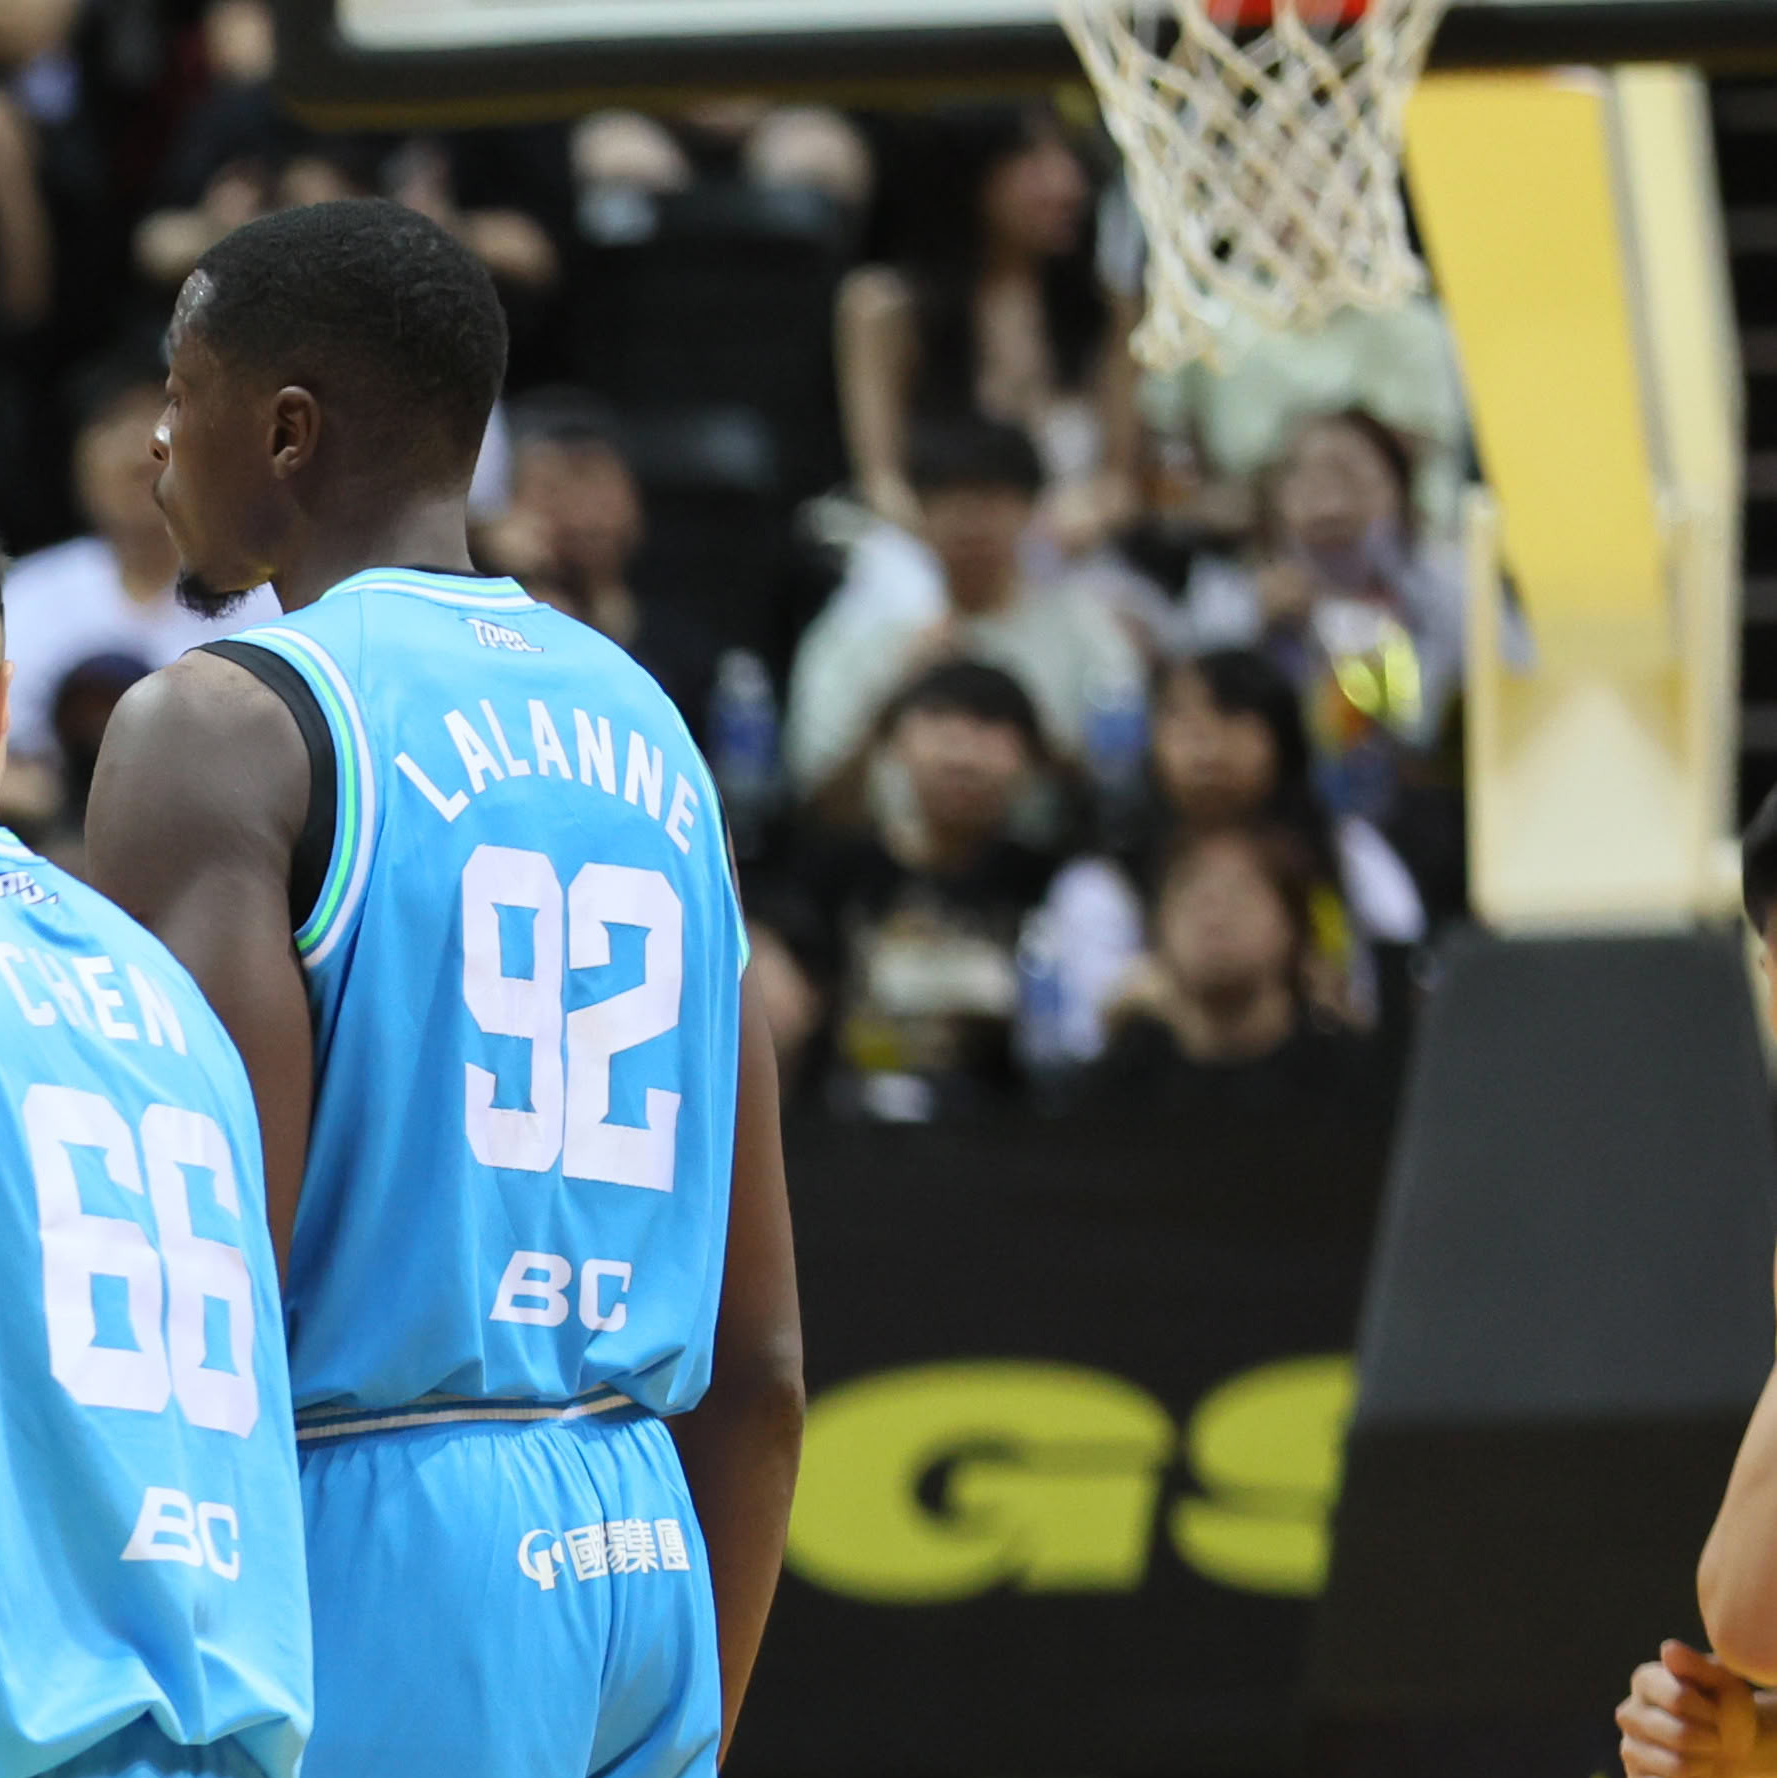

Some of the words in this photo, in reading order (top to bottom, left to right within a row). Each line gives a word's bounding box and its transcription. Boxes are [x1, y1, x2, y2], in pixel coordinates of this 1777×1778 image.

[394, 698, 698, 855] LALANNE
[463, 844, 684, 1191] 92
[21, 1083, 260, 1439] 66
[490, 1250, 632, 1332] BC
[121, 1486, 241, 1581] BC
